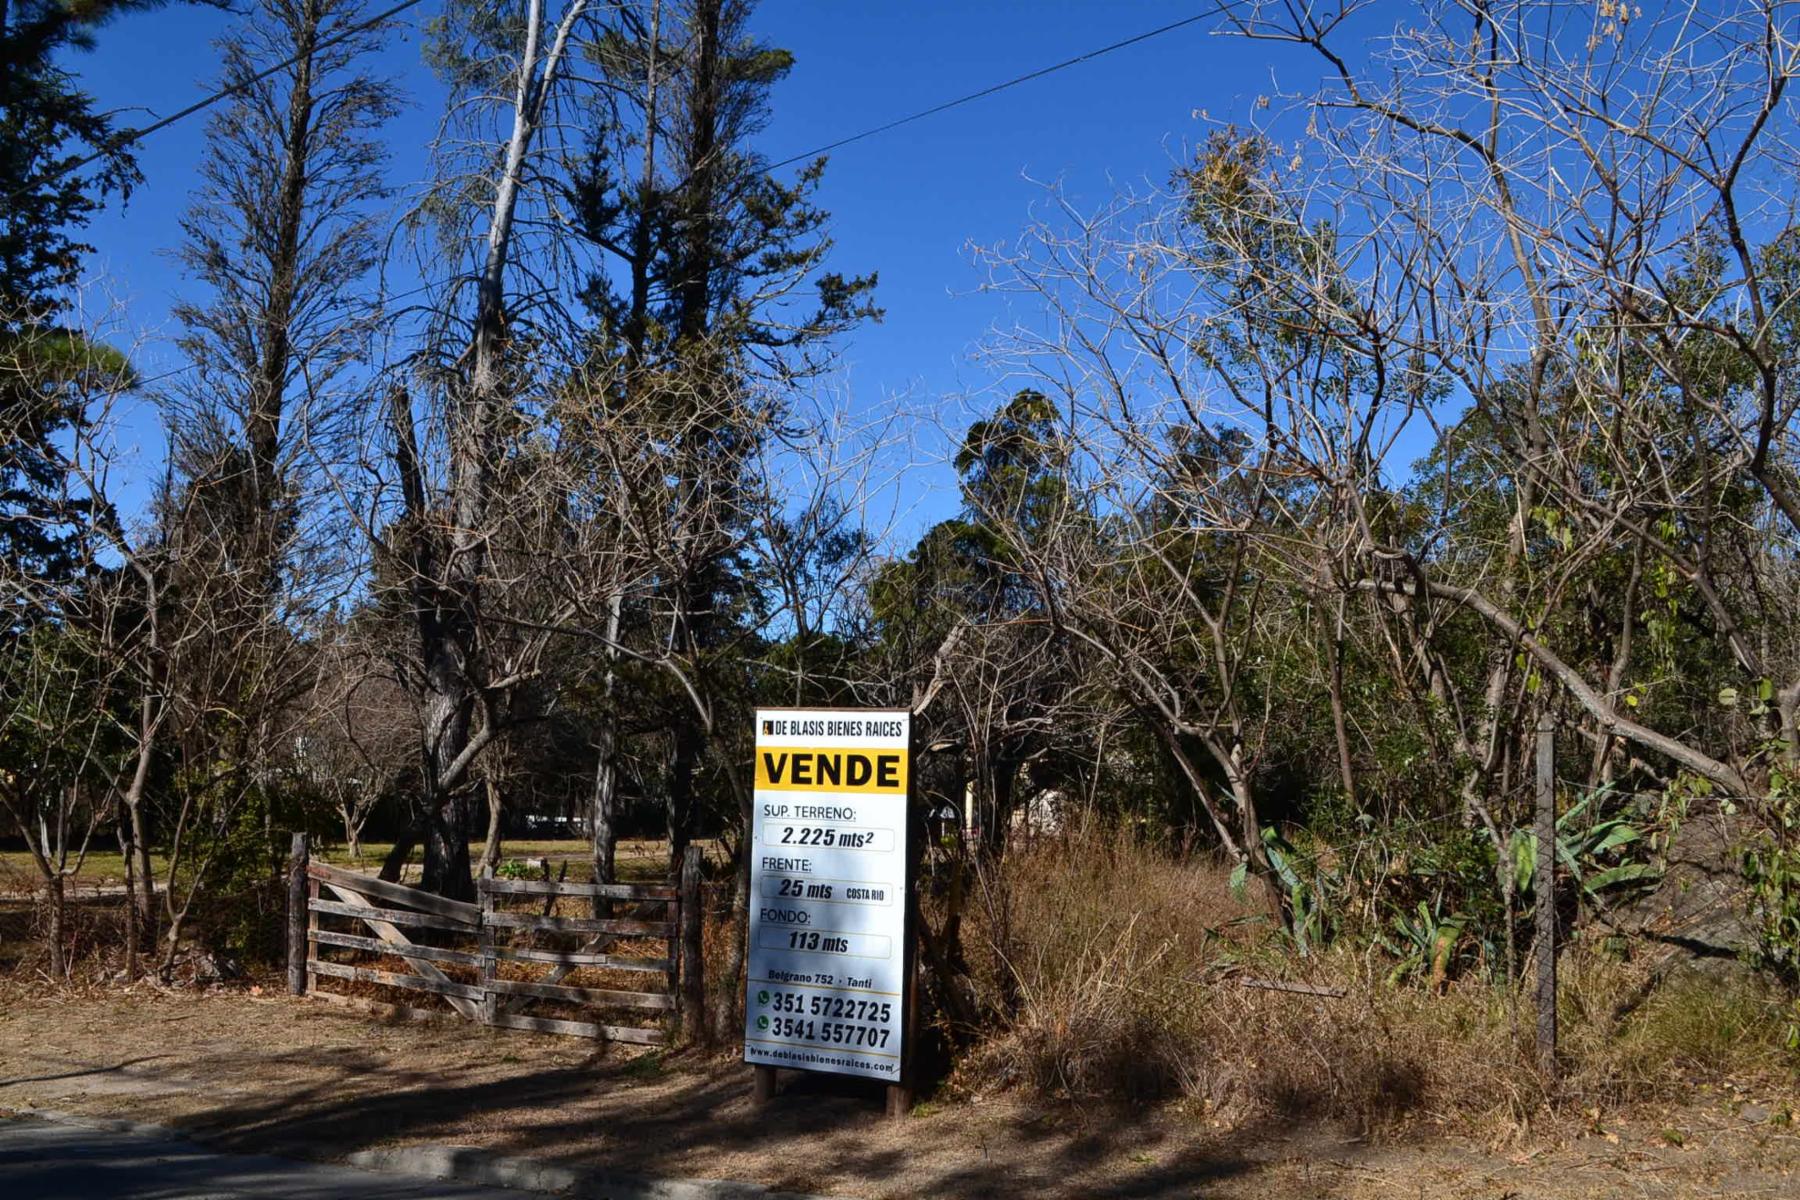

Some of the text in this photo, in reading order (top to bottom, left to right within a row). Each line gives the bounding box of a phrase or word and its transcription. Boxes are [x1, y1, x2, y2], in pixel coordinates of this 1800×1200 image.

[776, 720, 902, 737] DE BLASIS BIENES RAICES
[763, 752, 900, 787] VENDE
[764, 804, 856, 820] SUP. TERRENO:
[781, 826, 835, 846] 2.225
[762, 857, 812, 872] FRENTE:
[779, 879, 832, 899] 25 mts
[846, 887, 884, 900] COSTA RIO
[760, 908, 811, 924] FONDO:
[789, 932, 848, 953] 113 mts
[768, 970, 872, 988] Belgrano 752 Tanti
[772, 992, 891, 1023] 351 5722725
[772, 1017, 890, 1048] 3541 557707
[751, 1047, 893, 1072] www.deblasisbienesraices.com
